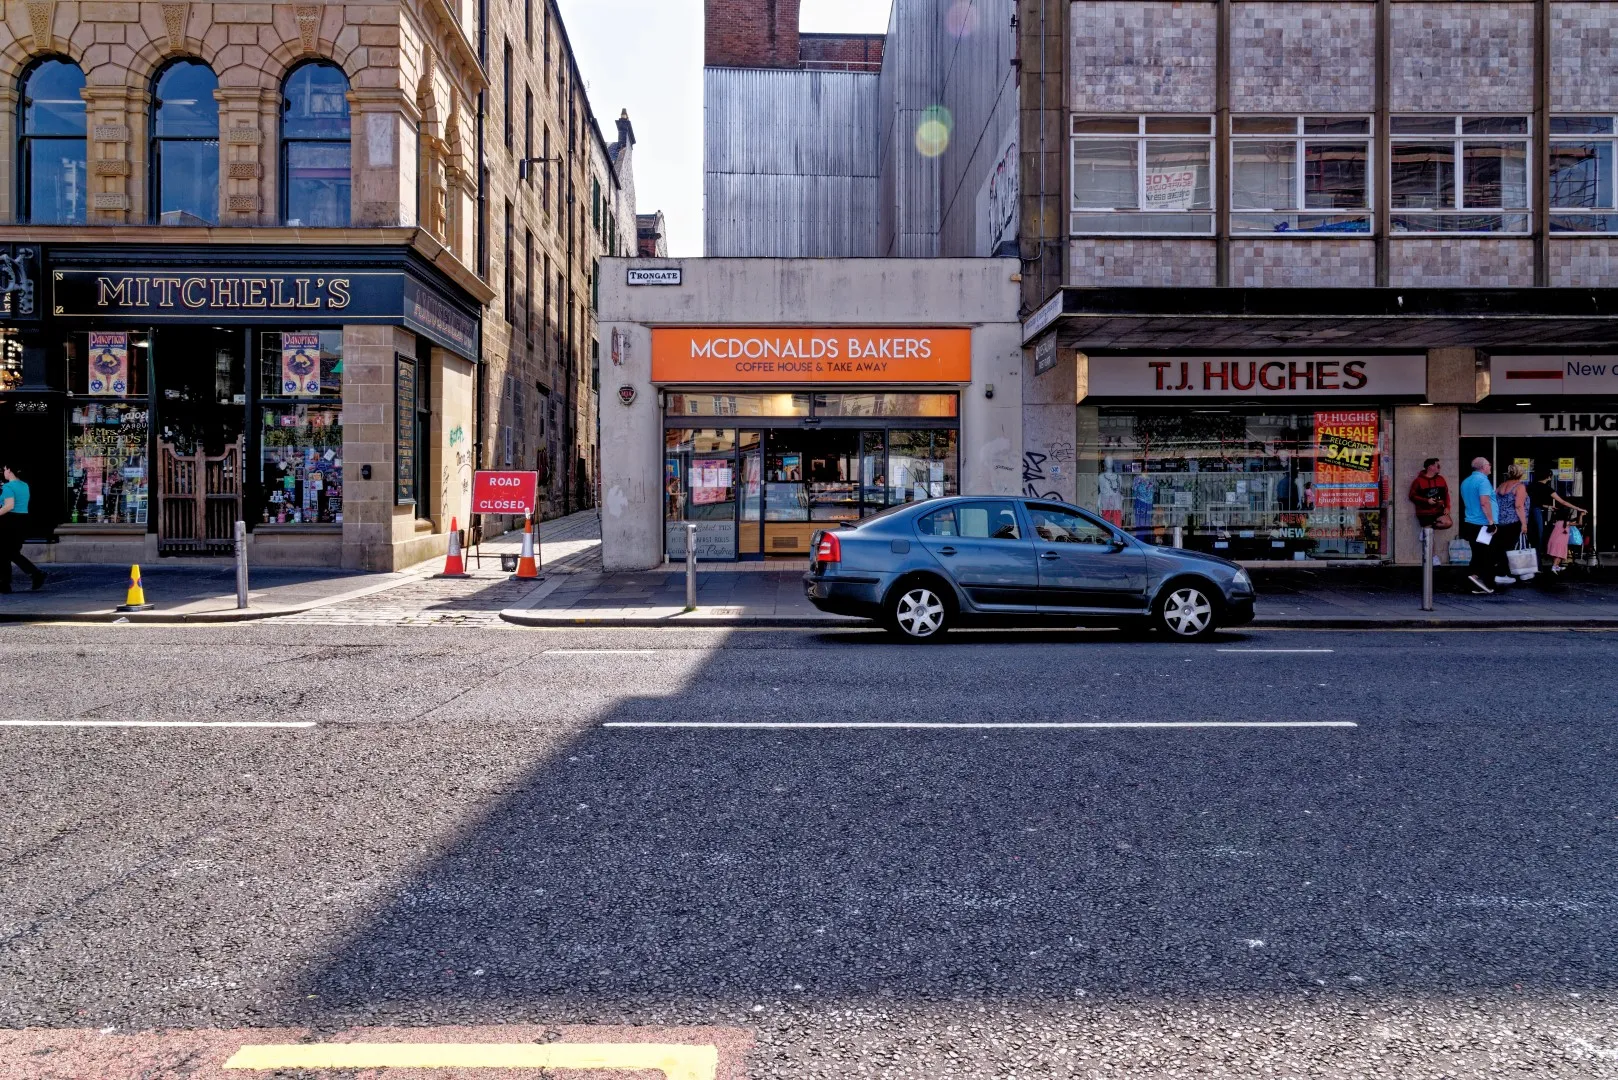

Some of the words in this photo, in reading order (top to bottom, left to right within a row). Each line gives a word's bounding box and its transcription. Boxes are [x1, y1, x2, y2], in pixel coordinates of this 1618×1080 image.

[98, 277, 351, 308] MITCHELL'S
[691, 338, 839, 359] MCDONALDS
[849, 338, 932, 359] BAKERS
[735, 362, 774, 372] COFFEE
[777, 362, 812, 372] HOUSE
[816, 362, 824, 372] &
[826, 362, 853, 372] TAKE
[856, 362, 887, 372] AWAY
[1567, 361, 1606, 376] New
[1149, 361, 1194, 390] T.J.
[1203, 360, 1368, 390] HUGHES
[1332, 413, 1376, 422] HUGHES
[1330, 437, 1374, 452] RELOCATION
[1326, 444, 1372, 468] SALE
[490, 478, 520, 486] ROAD
[480, 501, 524, 509] CLOSED
[1308, 514, 1355, 524] SEASON
[1280, 528, 1306, 538] NEW
